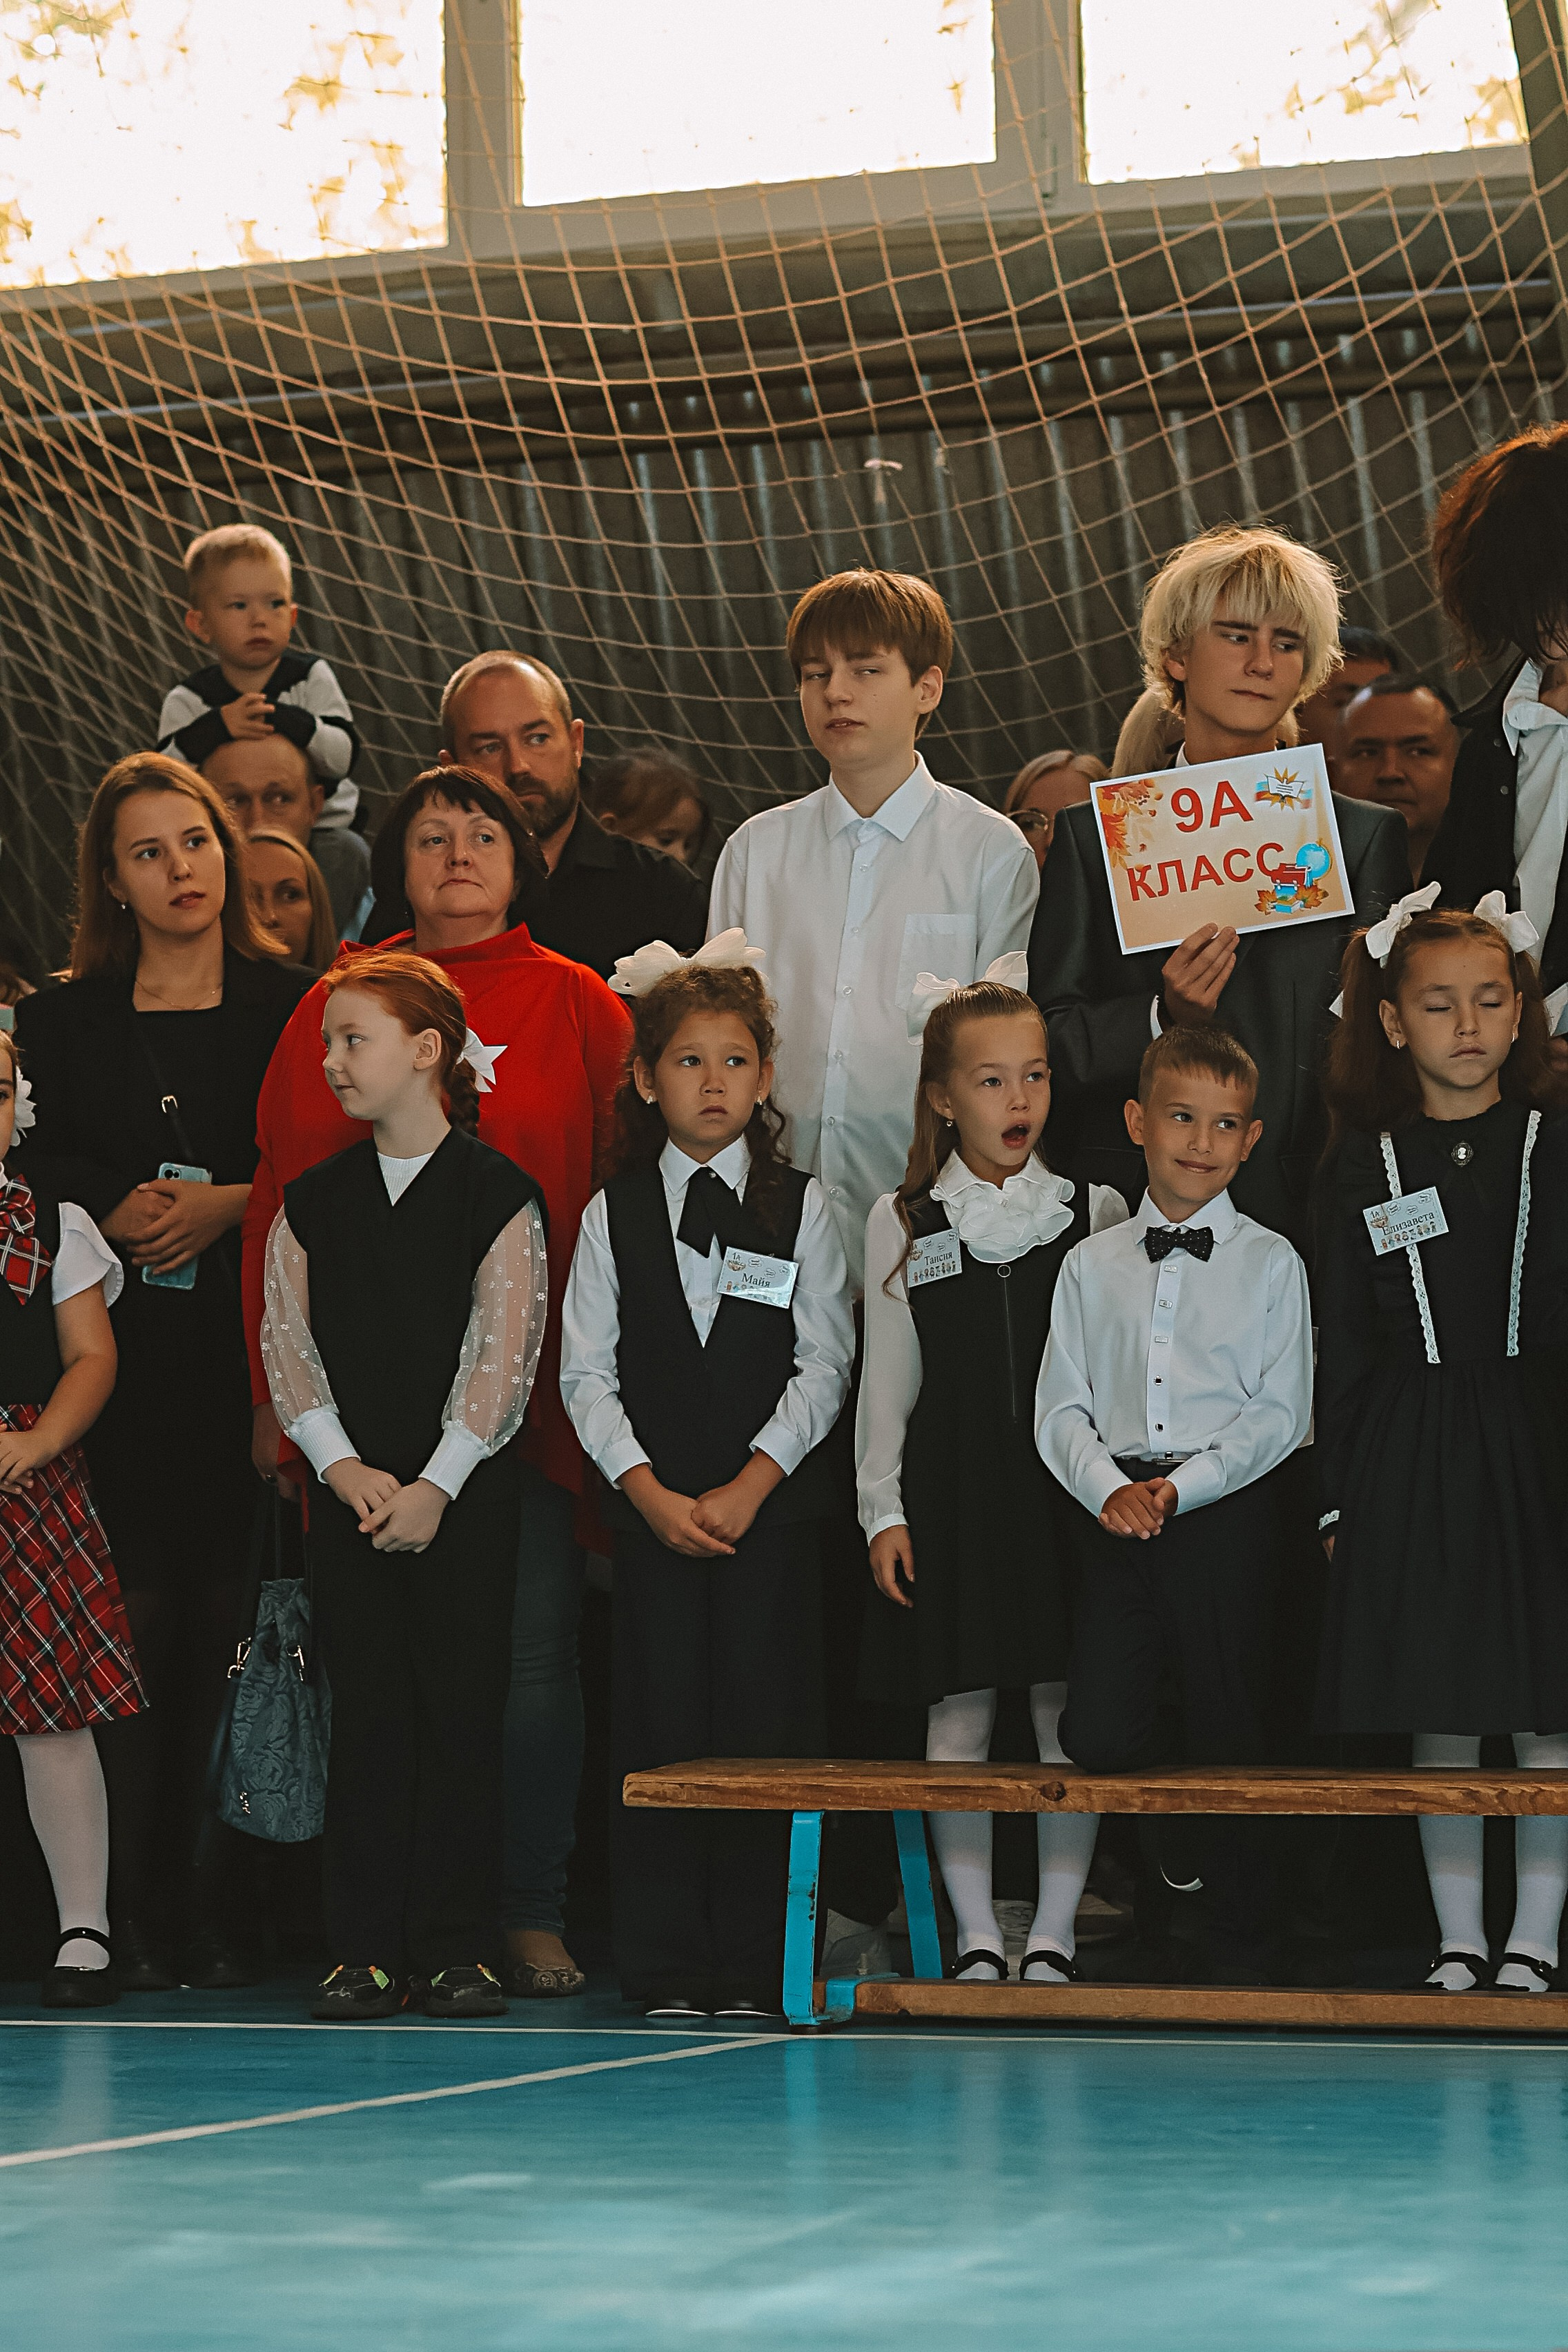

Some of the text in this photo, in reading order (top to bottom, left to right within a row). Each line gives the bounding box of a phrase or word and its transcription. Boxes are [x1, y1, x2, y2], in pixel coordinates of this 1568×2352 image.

[1170, 780, 1253, 832] 9А
[1126, 842, 1285, 902] КЛАСС
[1382, 1212, 1435, 1235] Елизавета
[924, 1251, 952, 1266] Таисия
[742, 1273, 771, 1288] Майя
